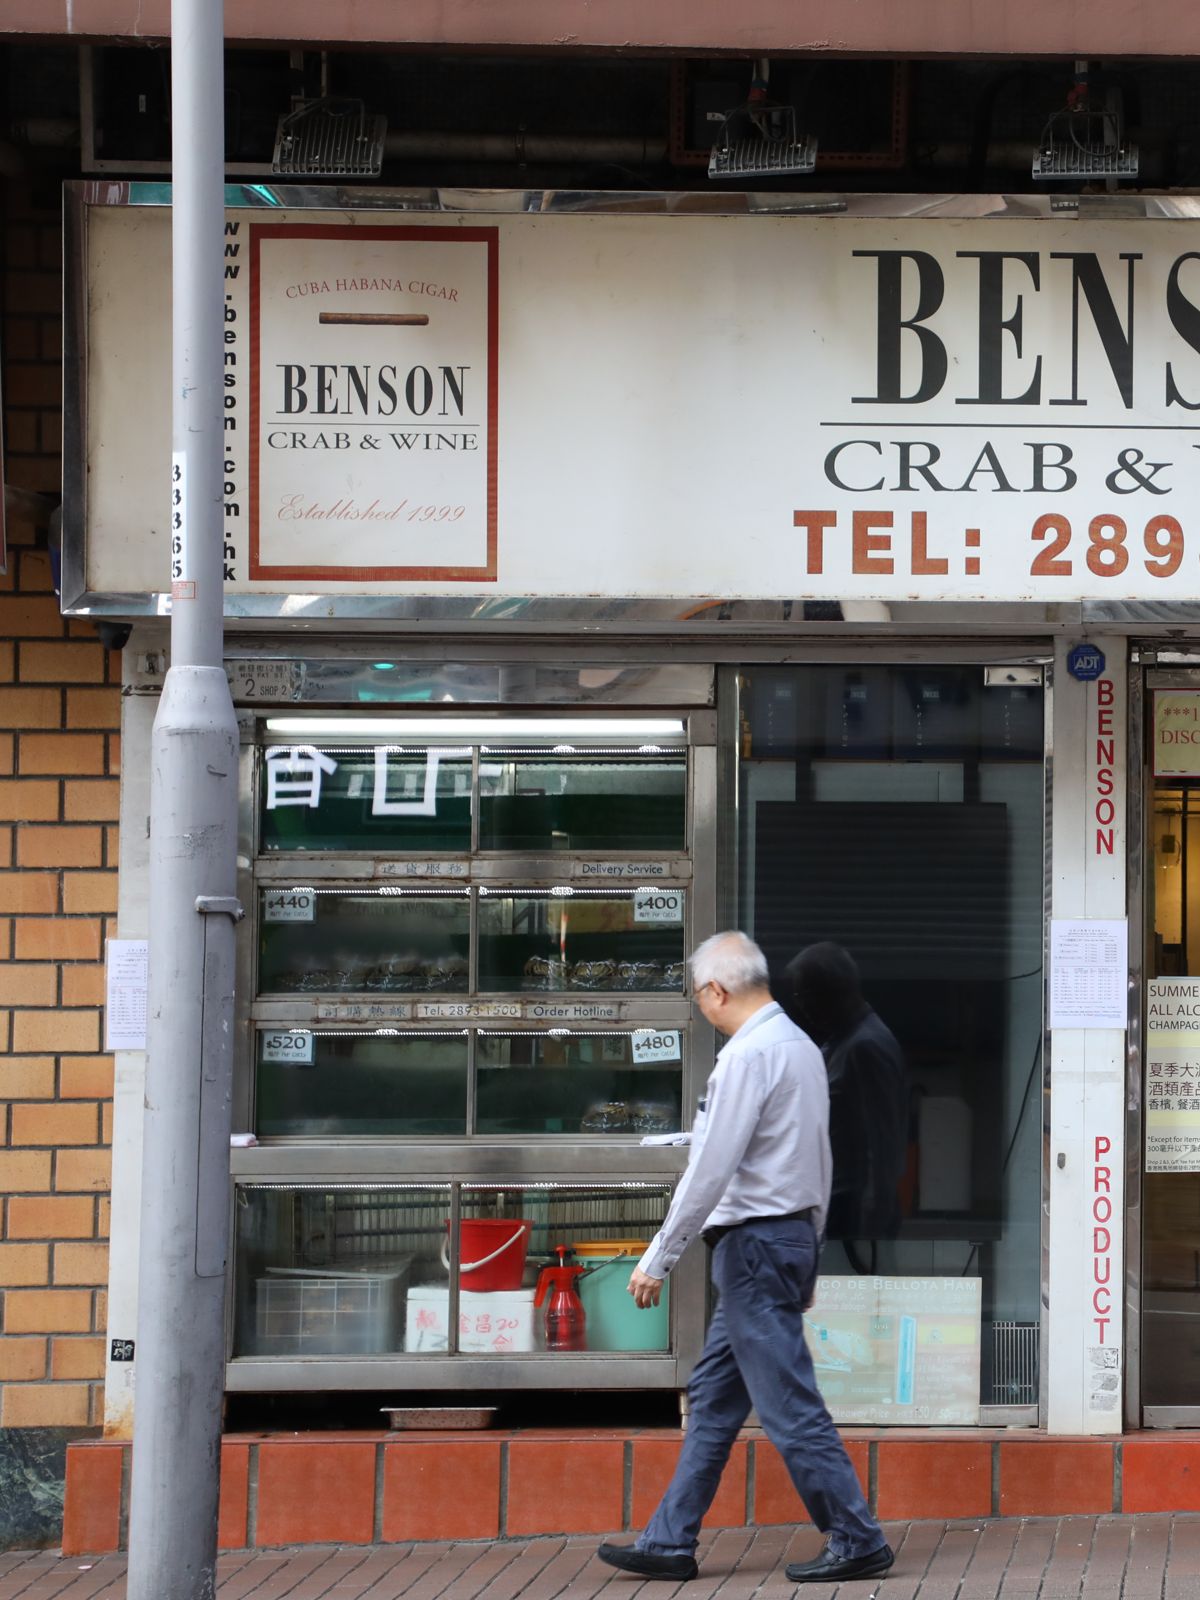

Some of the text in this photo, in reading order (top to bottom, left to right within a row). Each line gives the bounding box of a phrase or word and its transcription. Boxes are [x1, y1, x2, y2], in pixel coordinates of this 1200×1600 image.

[286, 278, 458, 302] CUBA HABANA CIGAR
[276, 364, 470, 416] BENSON
[267, 432, 478, 451] CRAB & WINE
[824, 441, 1077, 494] CRAB
[1106, 448, 1173, 496] &
[277, 493, 465, 522] Established 1999
[793, 510, 981, 575] TEL:
[1074, 655, 1099, 669] ADT
[245, 678, 287, 696] 2 SHOP 2
[1096, 680, 1115, 855] BENSON
[582, 864, 663, 875] Delivery Service
[268, 896, 309, 909] $440
[637, 897, 678, 909] $400
[424, 1005, 517, 1017] Tel: 2893 1500
[533, 1006, 613, 1017] Order Hotline
[1149, 1004, 1173, 1016] ALL
[266, 1036, 306, 1049] $520
[635, 1035, 675, 1051] $480
[1093, 1136, 1111, 1344] PRODUCT
[816, 1278, 976, 1290] ICO DE BELLOTA HAM
